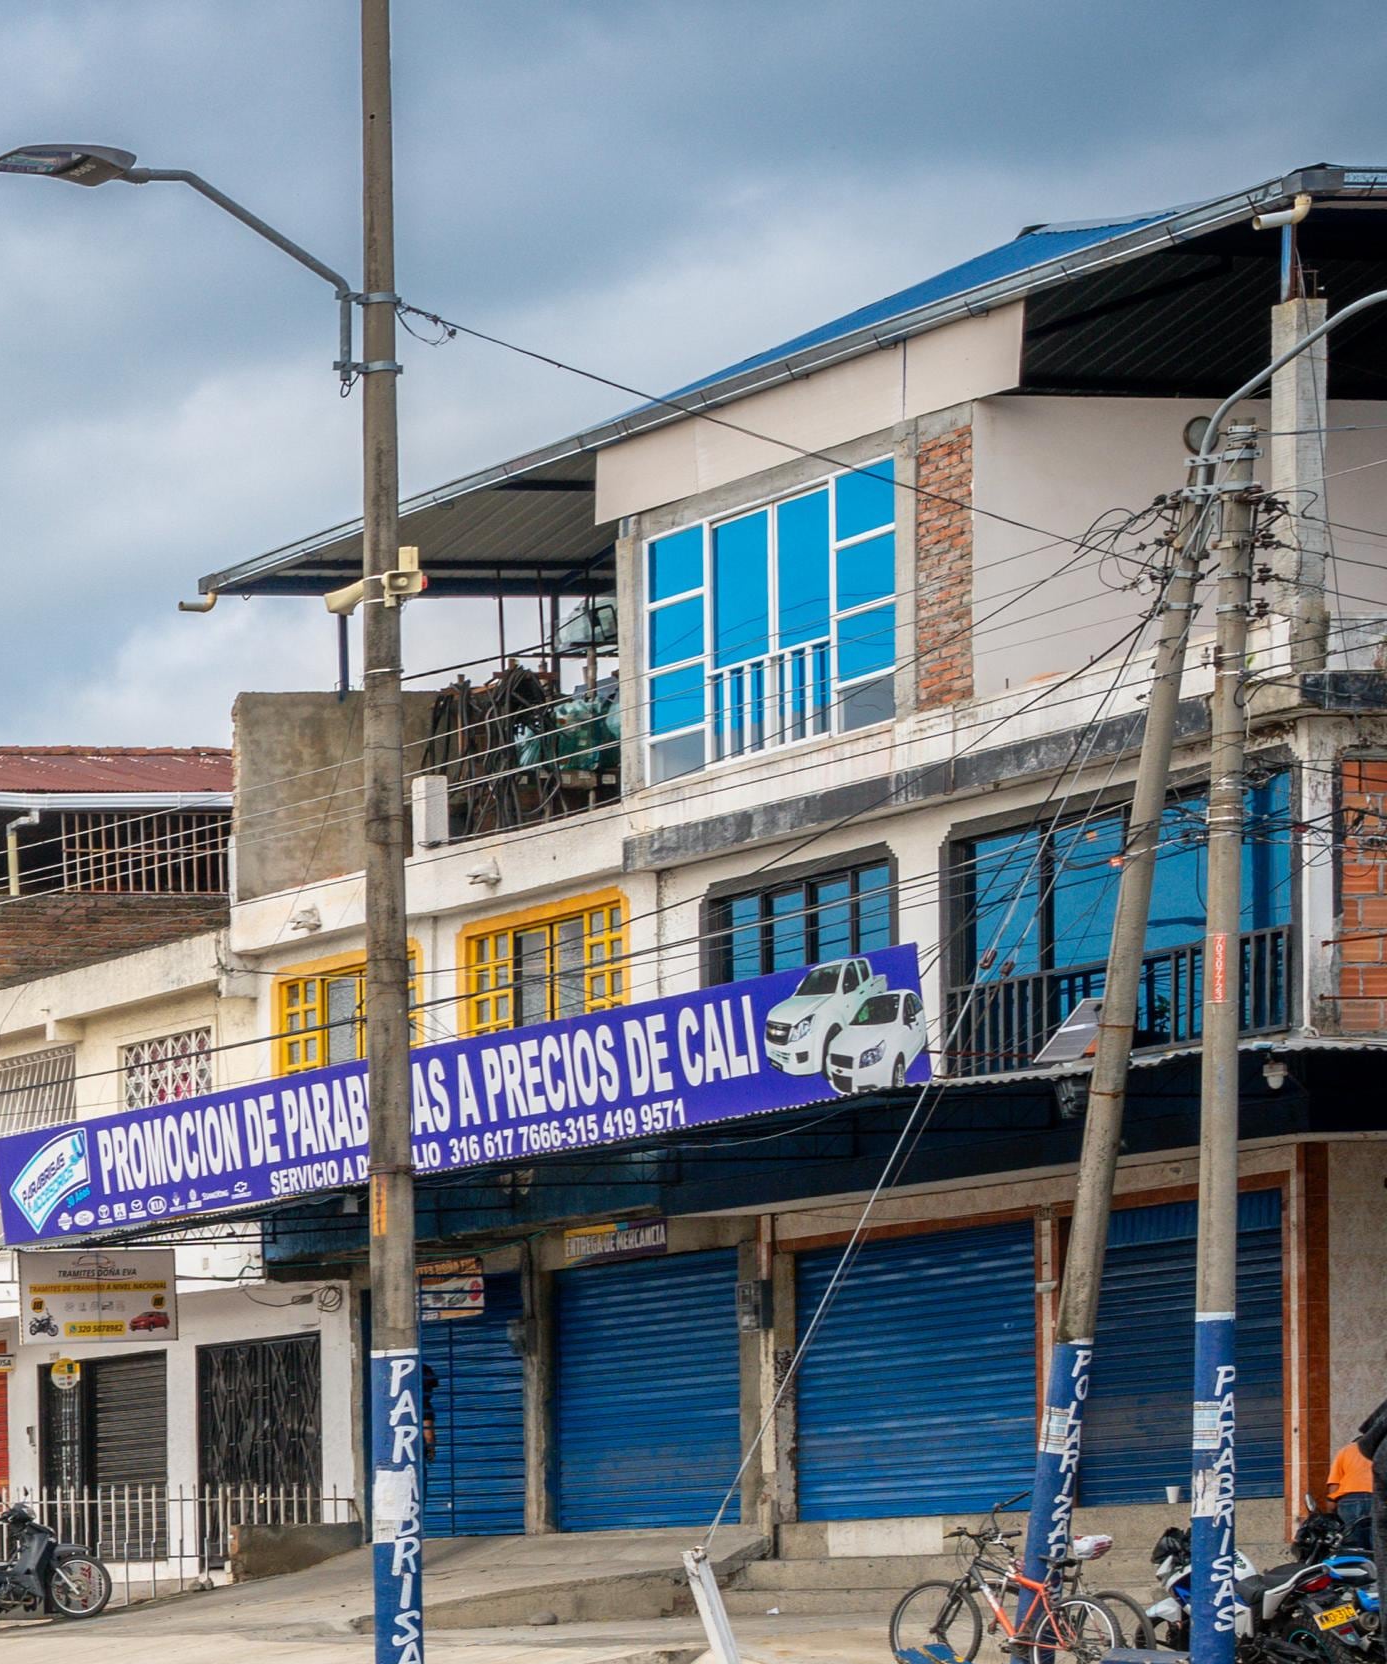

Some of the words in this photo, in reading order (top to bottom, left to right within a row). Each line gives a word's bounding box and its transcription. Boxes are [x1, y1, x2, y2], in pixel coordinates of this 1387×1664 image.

[1214, 936, 1223, 1002] 70307723
[97, 1102, 242, 1195] PROMOCION
[244, 1093, 281, 1167] DE
[281, 1057, 451, 1159] PARABAS
[457, 1053, 482, 1128] A
[480, 1024, 620, 1122] PRECIOS
[623, 1013, 673, 1097] DE
[678, 994, 760, 1087] CALI
[448, 1134, 479, 1165] 316
[483, 1129, 514, 1160] 617
[517, 1113, 599, 1152] 7666-315
[603, 1107, 637, 1138] 419
[641, 1098, 687, 1131] 9571
[270, 1160, 337, 1195] SERVICIO
[343, 1156, 355, 1182] A
[58, 1268, 95, 1278] TRAMITES
[96, 1267, 120, 1278] DOÑA
[122, 1268, 137, 1276] EVA
[566, 1234, 604, 1257] ENTREGA
[617, 1224, 667, 1250] MERCANCIA
[1211, 1364, 1236, 1632] PARABRISAS
